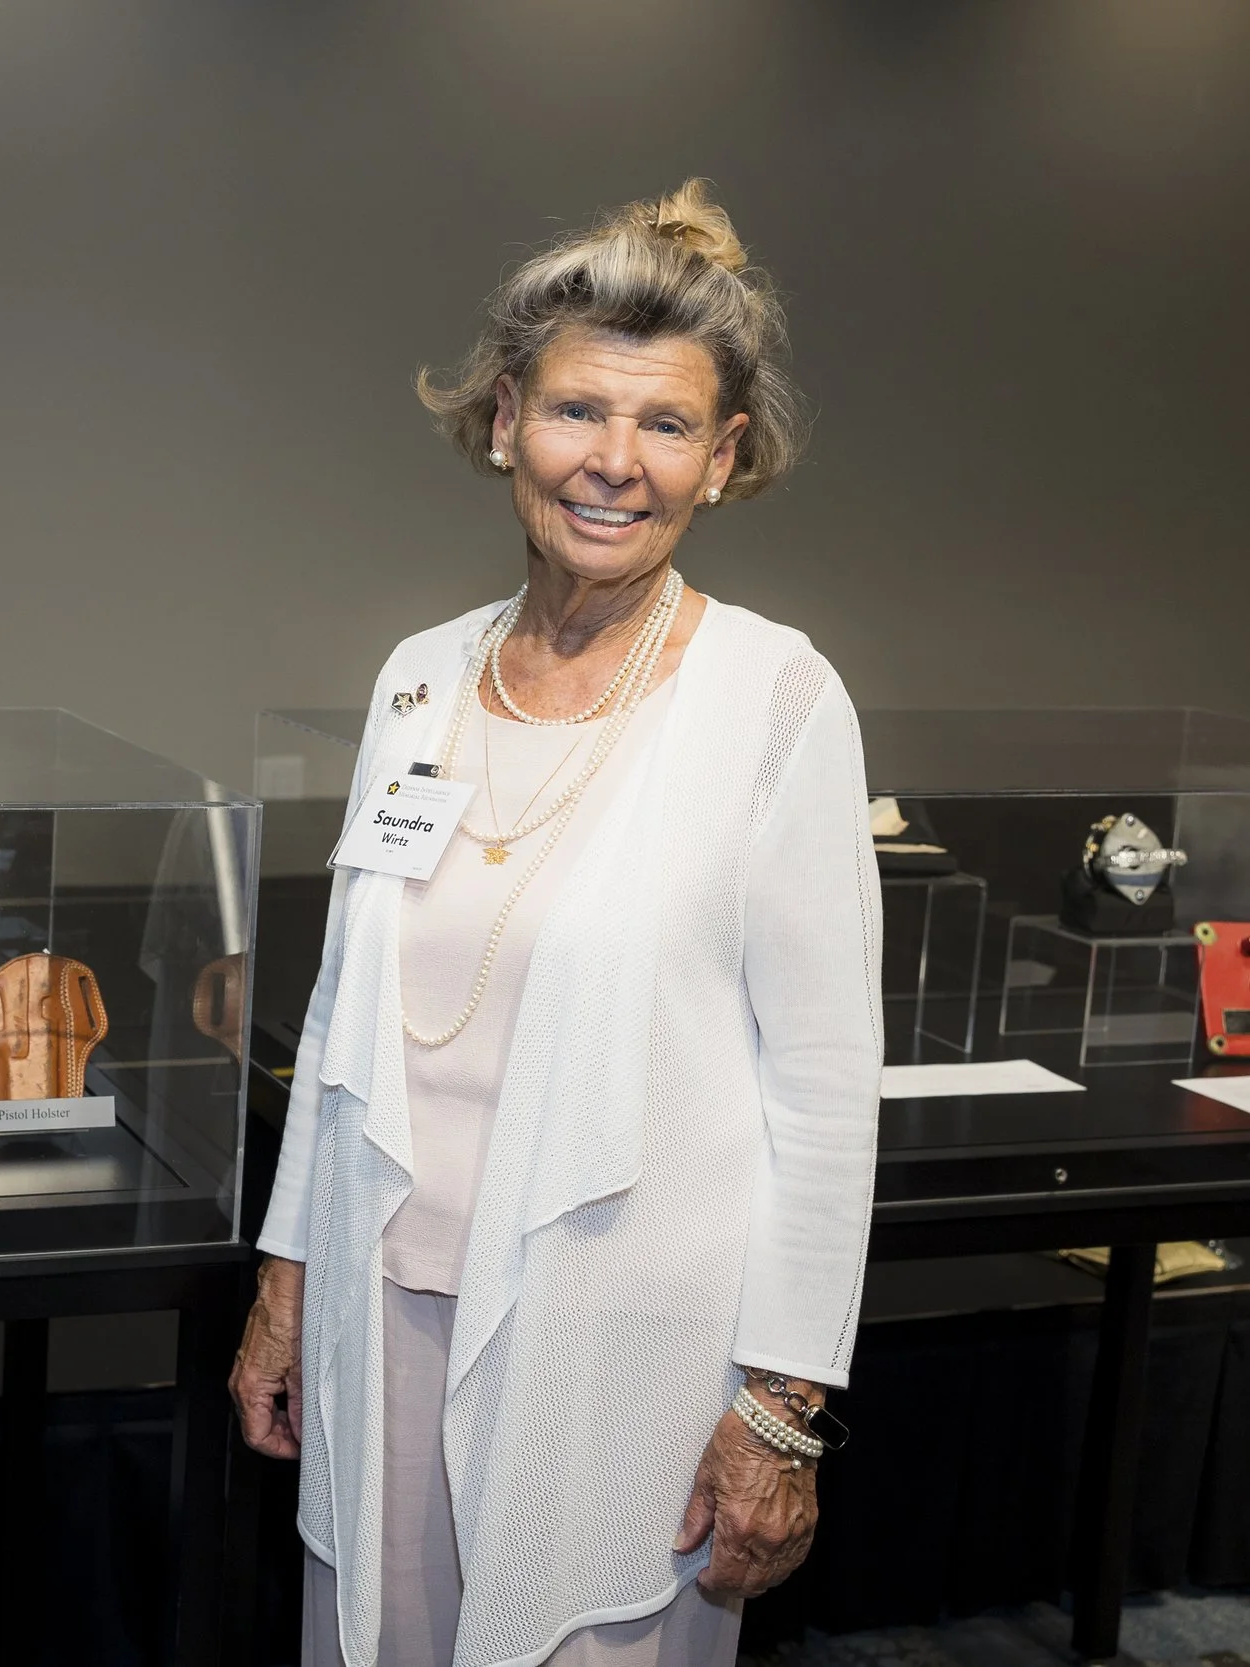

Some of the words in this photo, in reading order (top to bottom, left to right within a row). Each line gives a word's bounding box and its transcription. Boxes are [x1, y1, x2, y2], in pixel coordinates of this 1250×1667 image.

[373, 809, 434, 833] Saundra
[381, 832, 409, 847] Wirtz
[0, 1109, 28, 1121] Pistol
[32, 1108, 70, 1120] Holster
